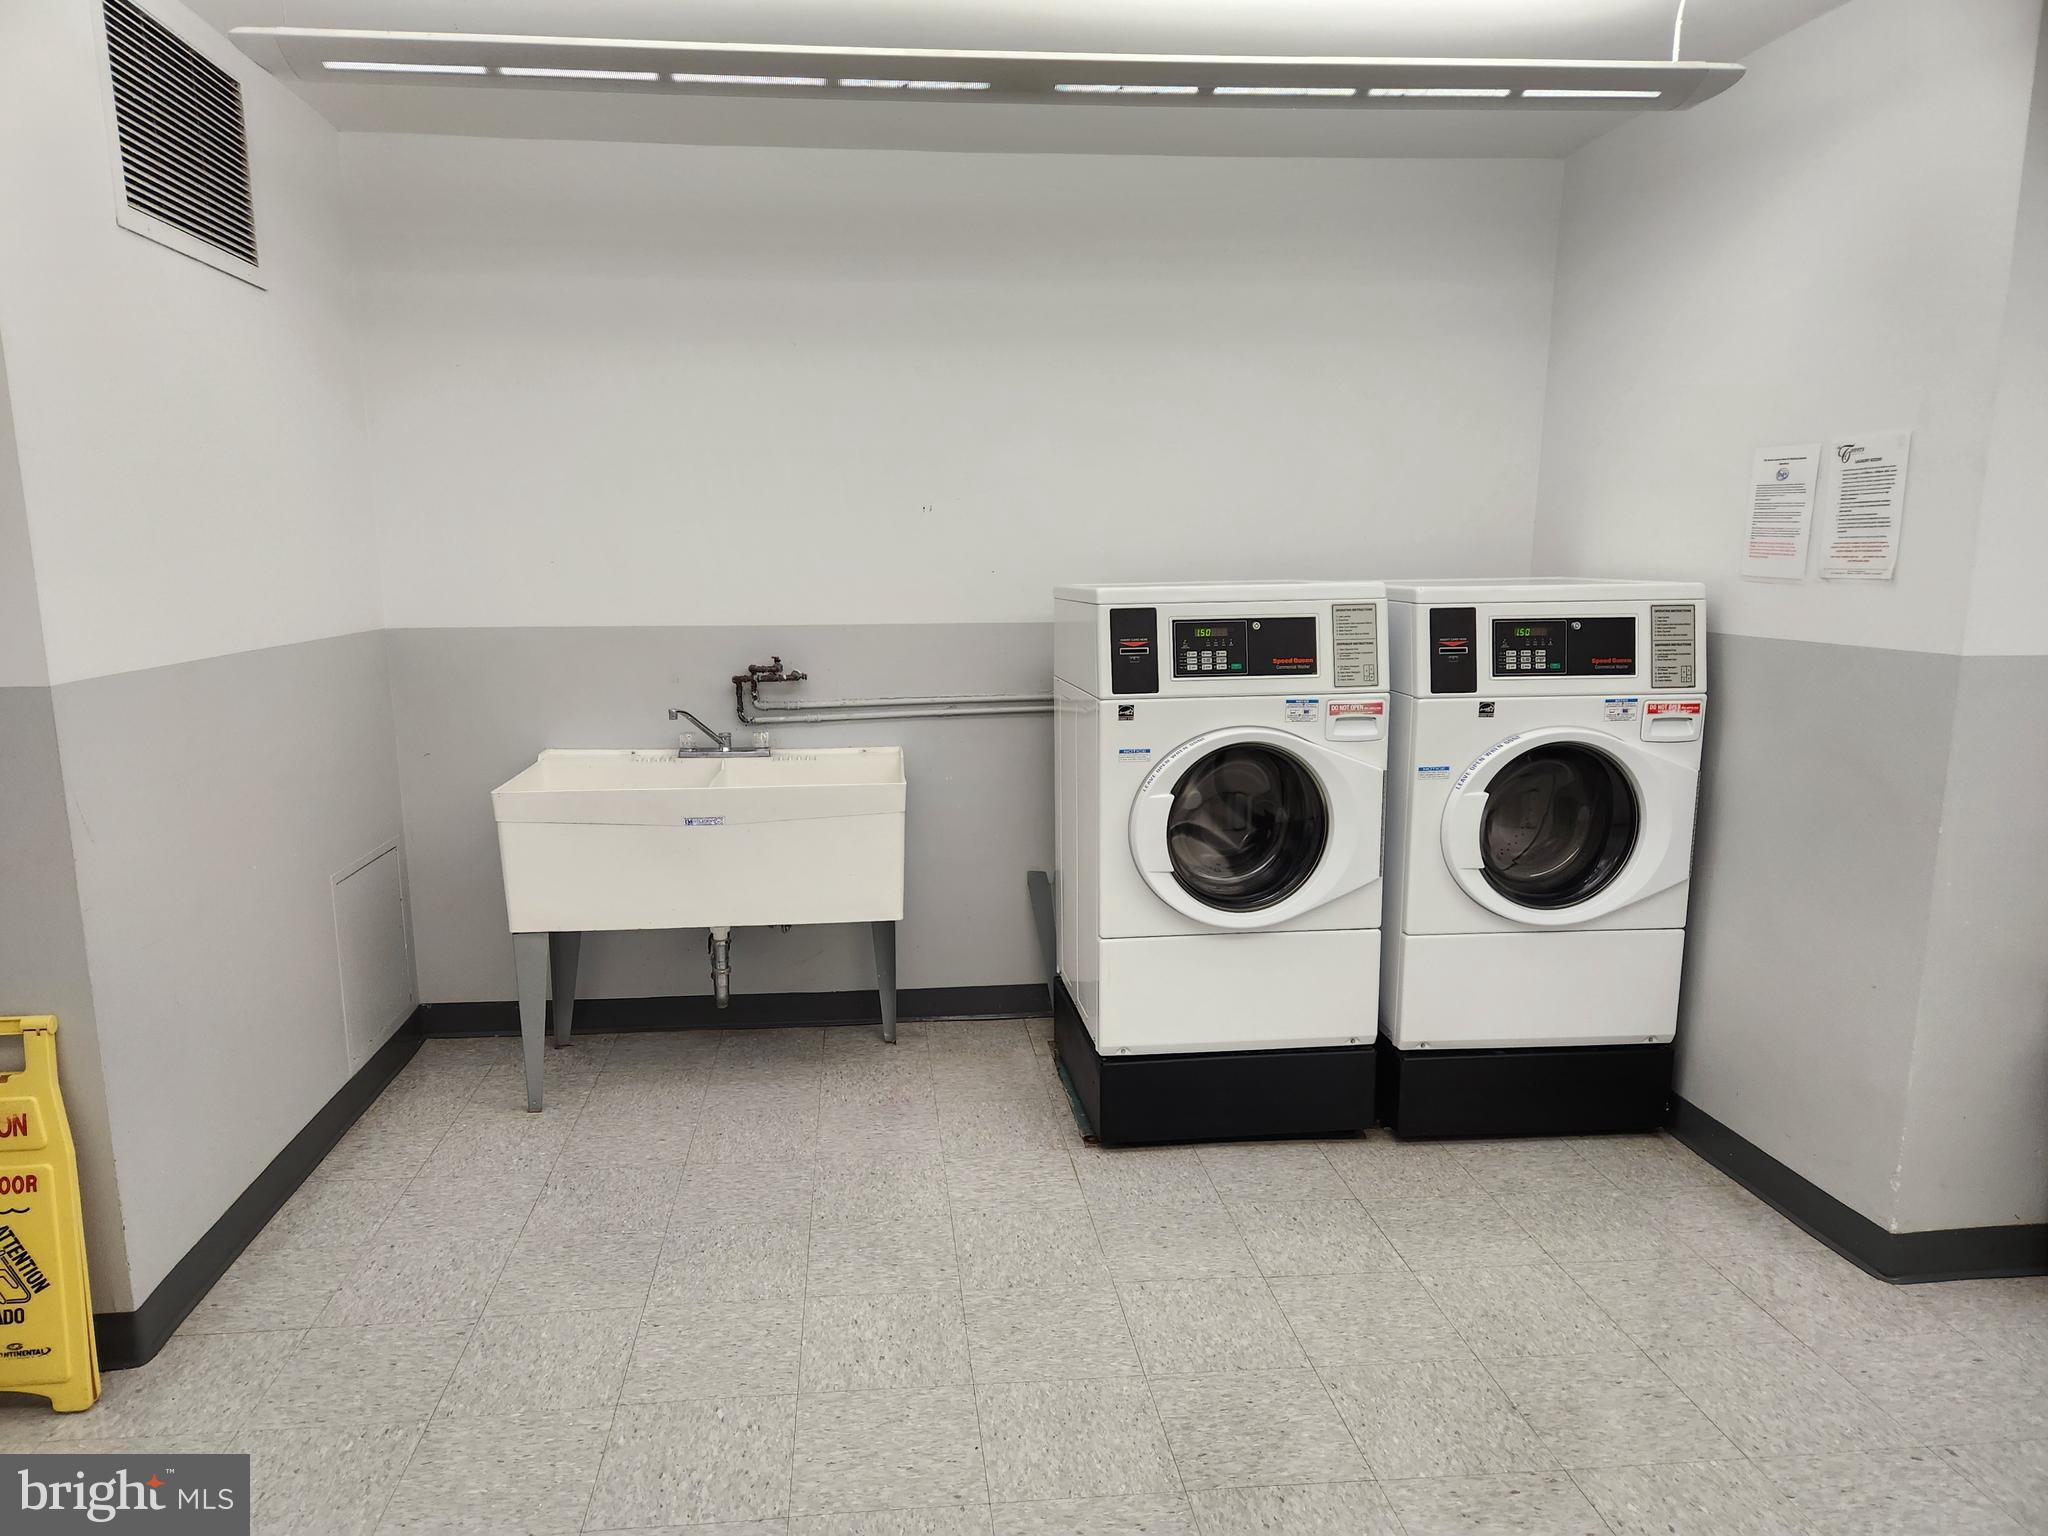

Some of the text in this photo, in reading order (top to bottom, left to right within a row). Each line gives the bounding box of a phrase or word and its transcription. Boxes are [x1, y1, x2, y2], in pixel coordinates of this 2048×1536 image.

[1156, 759, 1170, 773] OPEN
[1170, 746, 1188, 759] WHEN
[1456, 772, 1470, 790] LEAVE
[1470, 758, 1485, 770] OPEN
